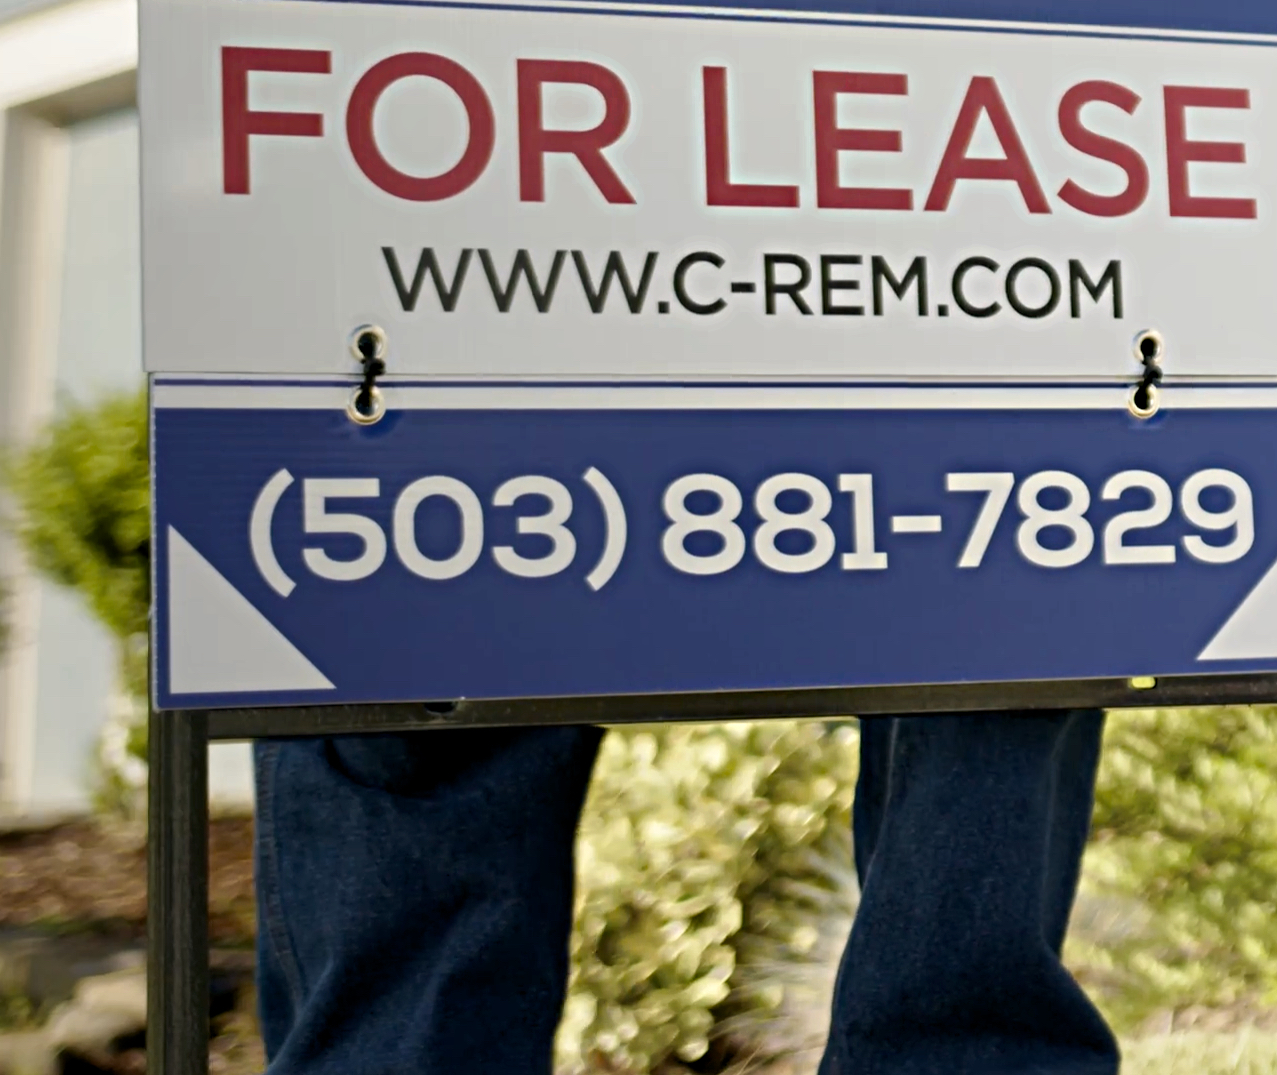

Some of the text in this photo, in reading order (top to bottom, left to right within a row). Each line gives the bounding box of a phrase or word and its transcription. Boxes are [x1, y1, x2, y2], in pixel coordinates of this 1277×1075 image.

[220, 45, 1257, 220] FOR LEASE
[380, 245, 1124, 320] WWW.C-REM.COM
[249, 467, 1256, 598] (503) 881-7829
